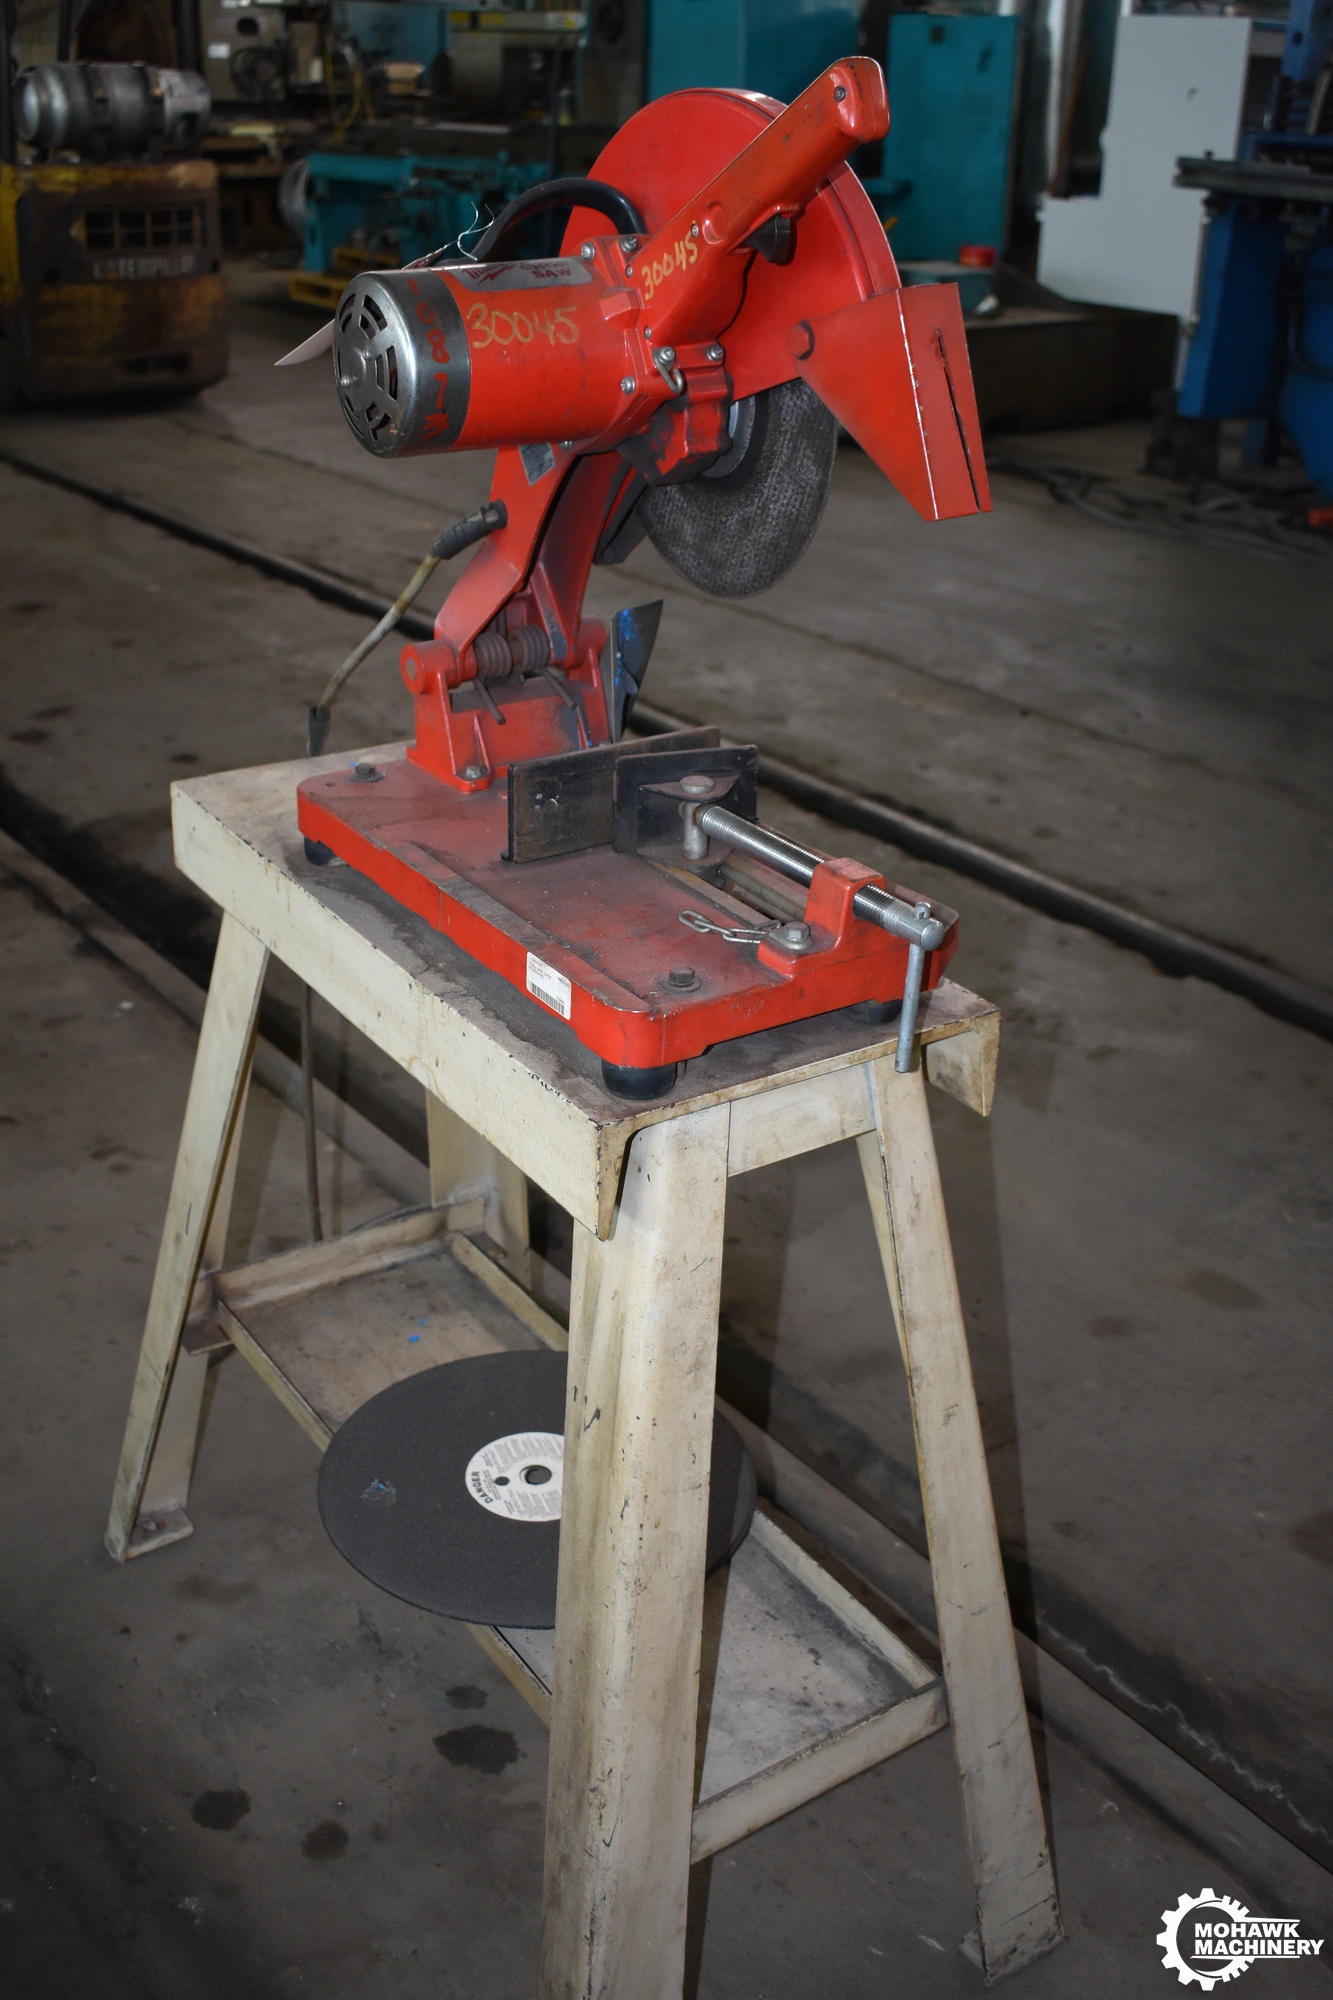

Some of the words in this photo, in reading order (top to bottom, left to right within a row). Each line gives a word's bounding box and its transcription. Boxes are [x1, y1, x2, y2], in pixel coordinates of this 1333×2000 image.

[532, 267, 572, 279] SAW
[641, 221, 698, 301] 30045
[466, 302, 579, 349] 30045
[471, 1470, 494, 1504] DANGER
